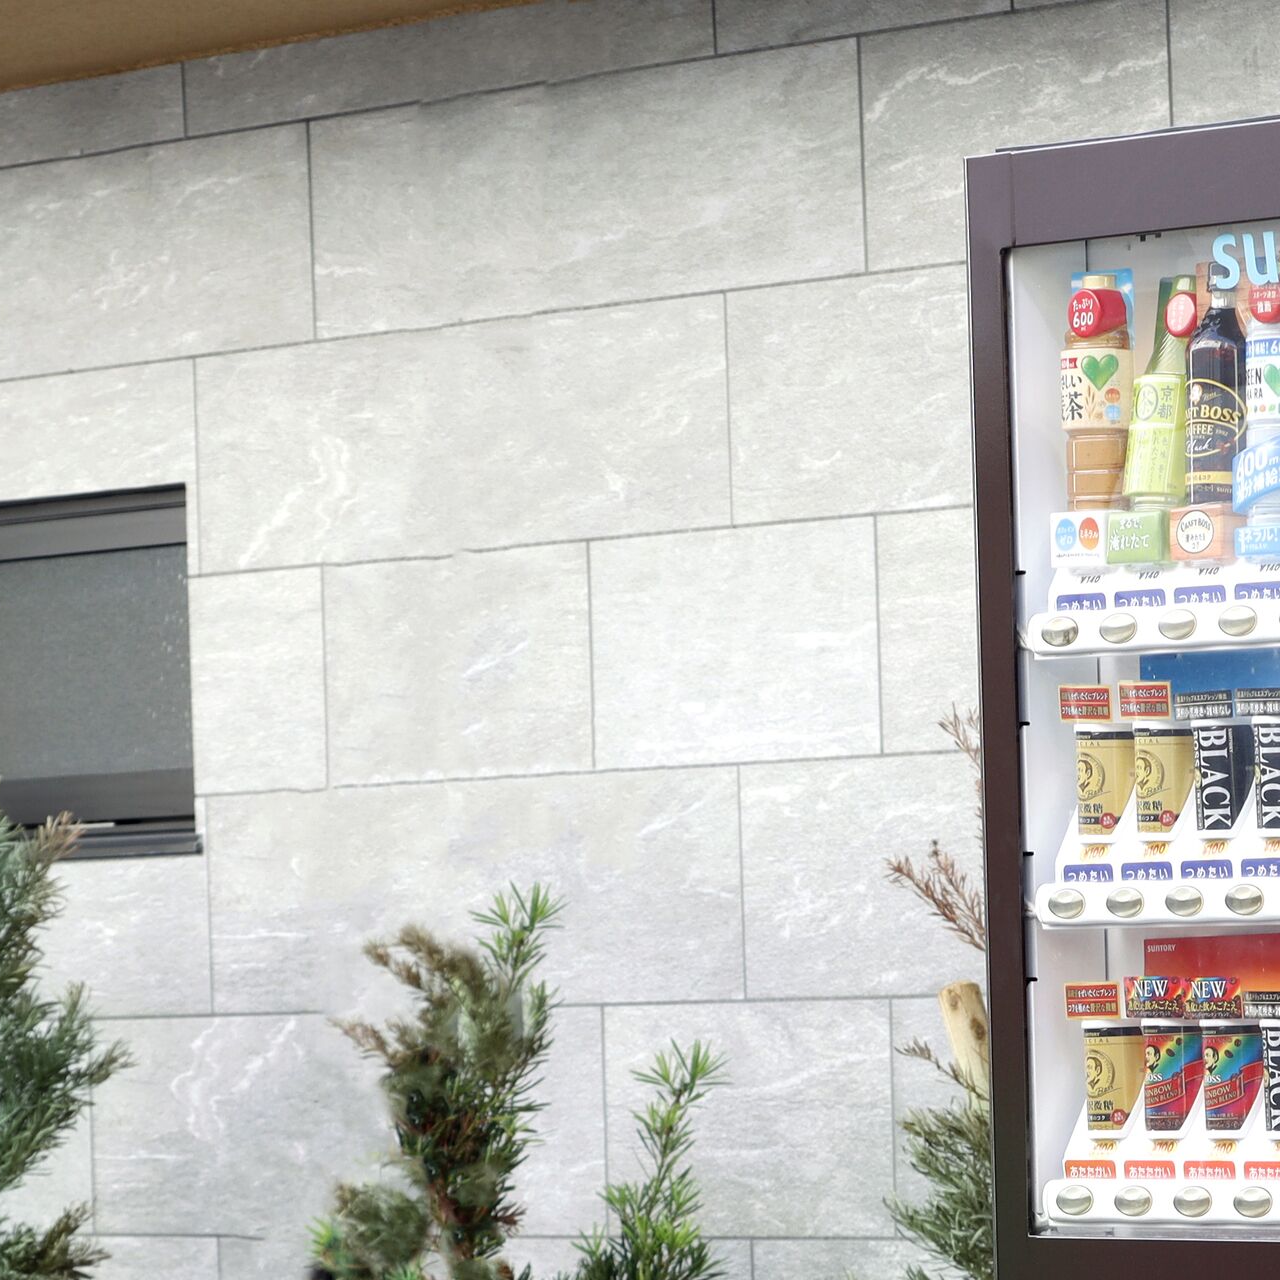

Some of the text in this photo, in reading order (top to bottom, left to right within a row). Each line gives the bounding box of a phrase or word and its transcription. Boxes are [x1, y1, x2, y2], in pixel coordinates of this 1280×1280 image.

[1073, 298, 1094, 311] たっぷり
[1073, 312, 1094, 328] 600
[1157, 384, 1173, 420] 京都
[1200, 404, 1242, 425] BOSS
[1119, 594, 1162, 608] つめたい
[1178, 590, 1222, 604] つめたい
[1060, 599, 1103, 611] つめたい
[1198, 727, 1232, 830] BLACK
[1068, 870, 1110, 882] つめたい
[1125, 868, 1169, 881] つめたい
[1184, 866, 1229, 879] つめたい
[1147, 944, 1176, 953] SUNTORY
[1133, 980, 1168, 999] NEW
[1190, 980, 1227, 999] NEW
[1070, 1165, 1112, 1179] あたたかい
[1128, 1166, 1171, 1179] あたたかい
[1188, 1167, 1232, 1180] あたたかい
